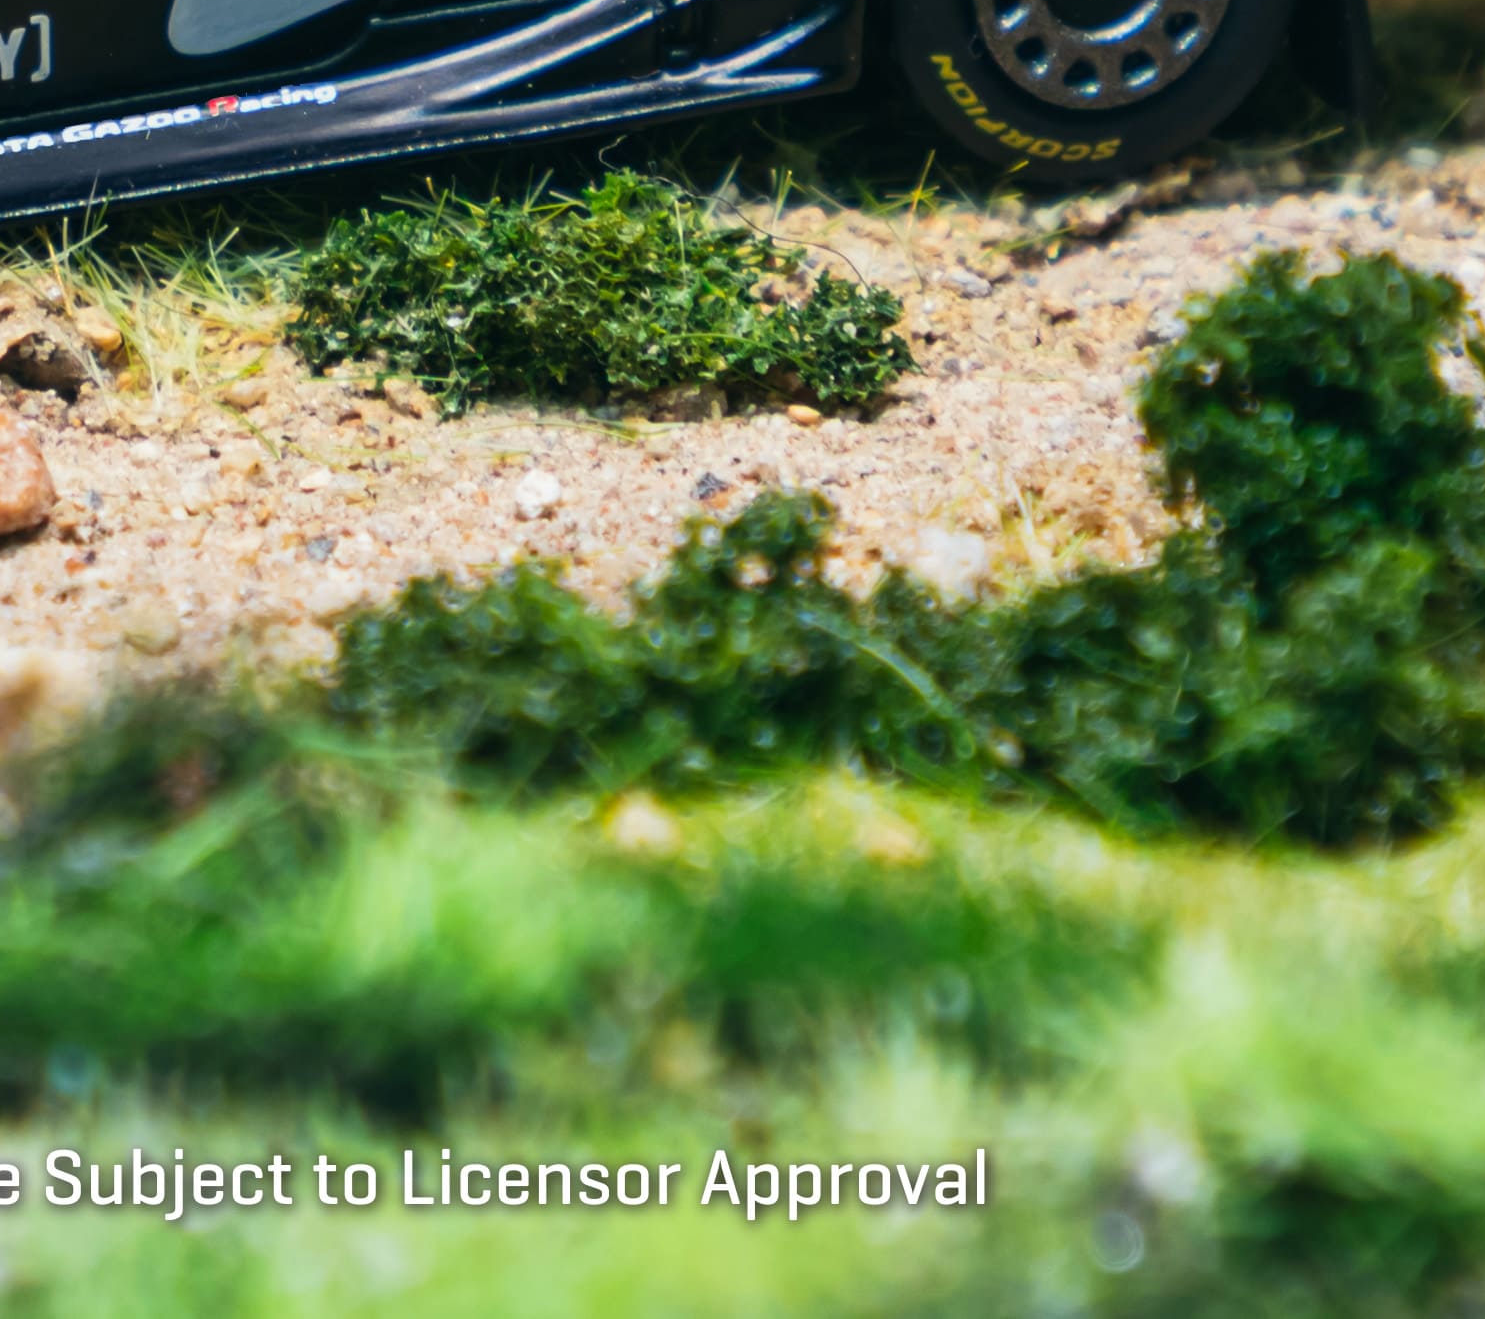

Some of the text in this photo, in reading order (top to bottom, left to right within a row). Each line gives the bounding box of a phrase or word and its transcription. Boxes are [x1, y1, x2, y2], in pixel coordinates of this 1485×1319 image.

[61, 106, 202, 144] GAZOO
[206, 84, 337, 119] Racing
[930, 53, 1122, 162] SCORPION
